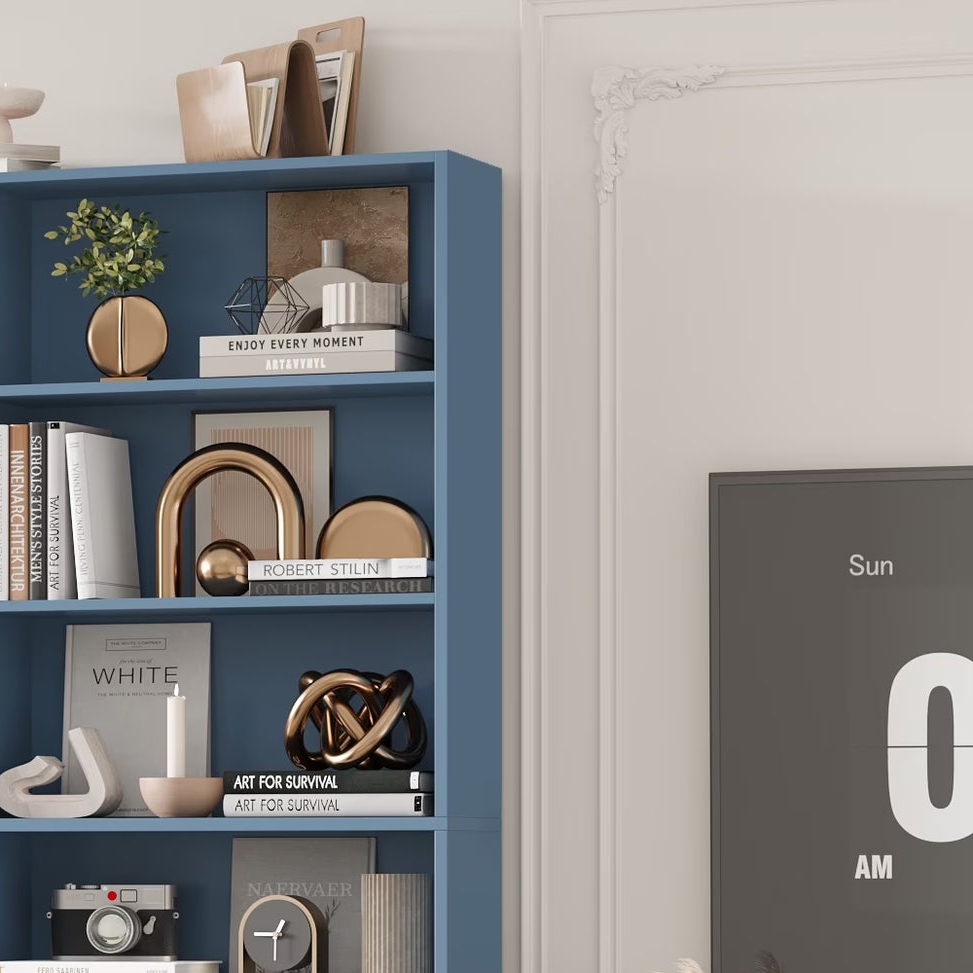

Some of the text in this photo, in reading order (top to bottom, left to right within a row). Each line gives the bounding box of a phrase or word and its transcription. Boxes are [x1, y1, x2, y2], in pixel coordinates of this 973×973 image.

[228, 336, 364, 351] ENJOY EVERY MOMENT
[30, 435, 43, 492] STORIES
[11, 450, 25, 592] INNENARCHITEKTUR
[30, 495, 43, 538] STYLE
[49, 496, 60, 590] ART FOR SURVIVAL
[263, 562, 379, 576] ROBERT STILIN
[849, 554, 893, 576] Sun
[255, 580, 423, 596] ON THE RESEARCH
[92, 666, 178, 685] WHITE
[233, 775, 338, 789] ART FOR SURVIVAL
[234, 798, 339, 812] ART FOR SURVIVAL
[854, 854, 893, 880] AM
